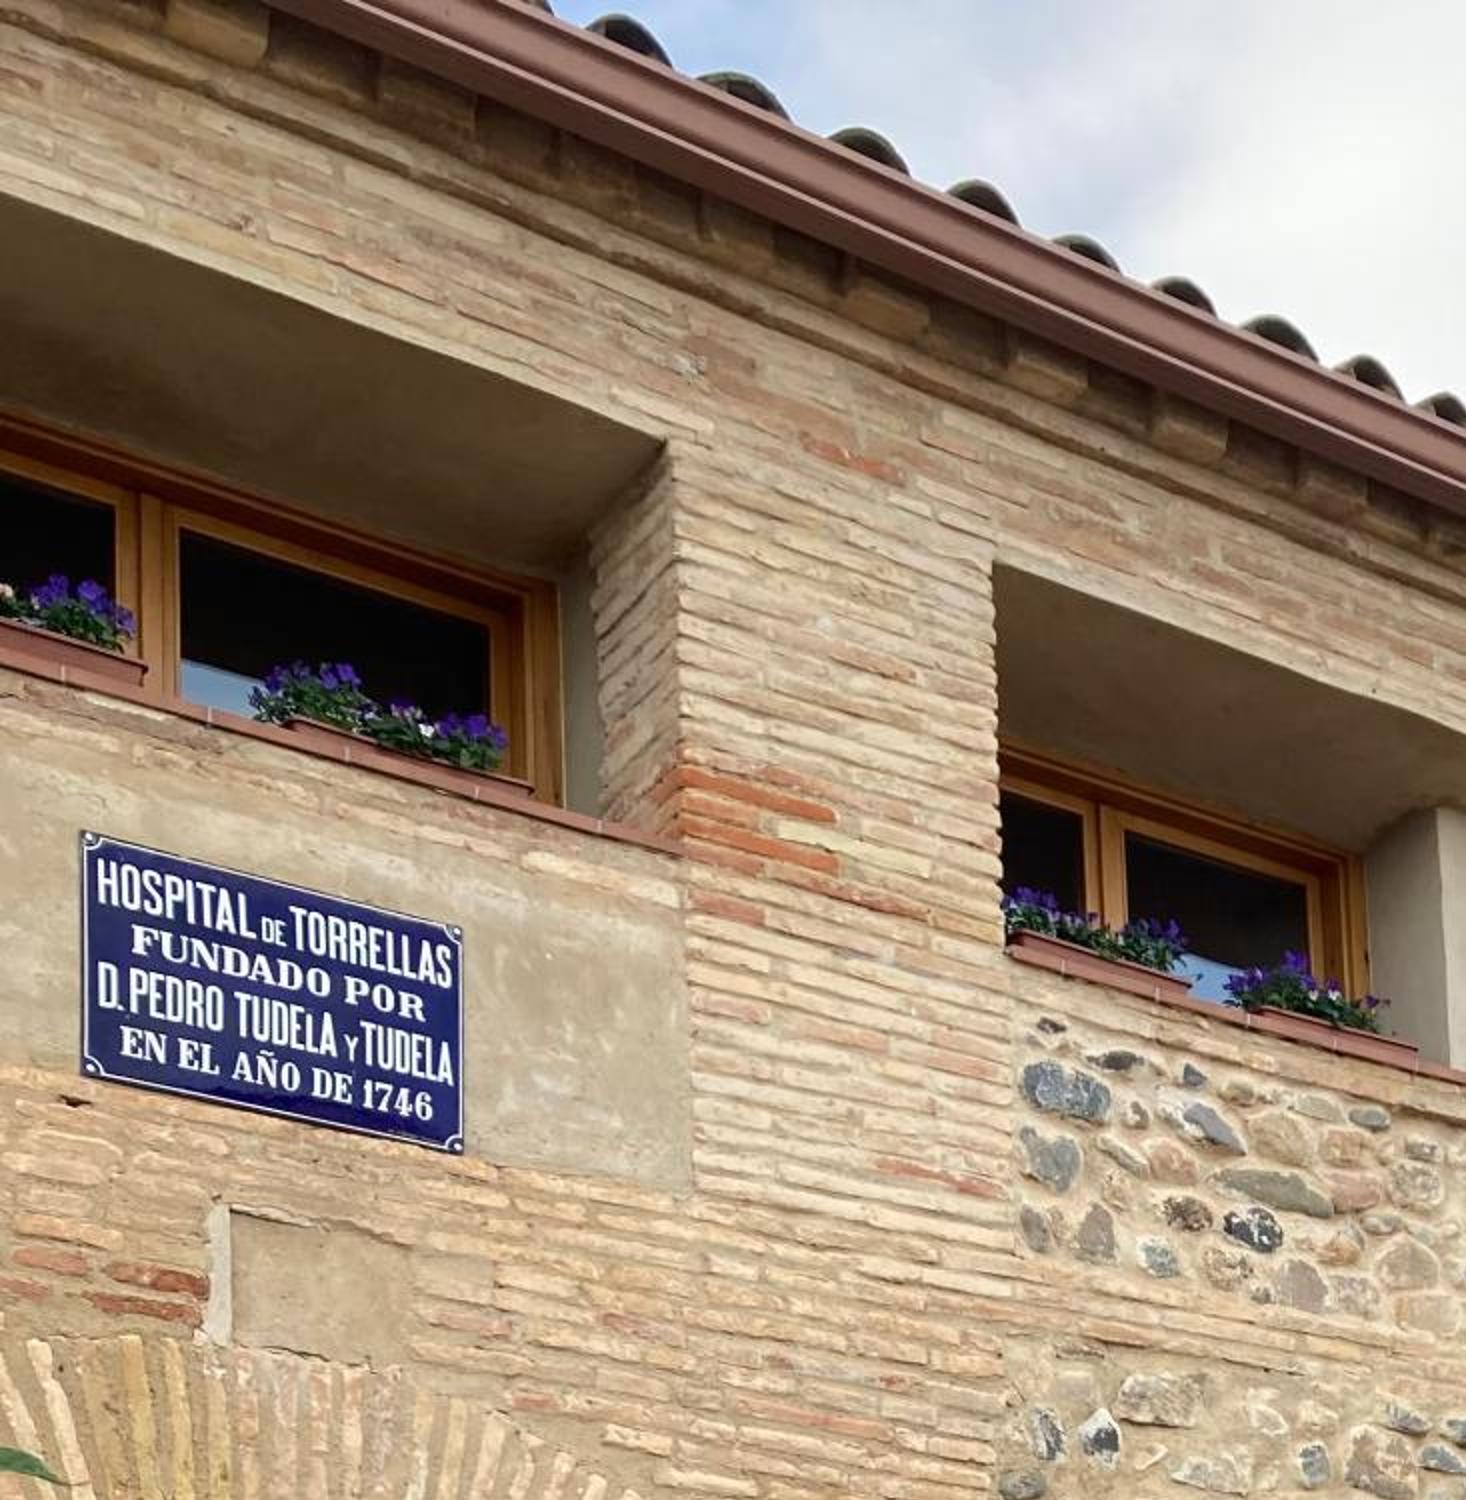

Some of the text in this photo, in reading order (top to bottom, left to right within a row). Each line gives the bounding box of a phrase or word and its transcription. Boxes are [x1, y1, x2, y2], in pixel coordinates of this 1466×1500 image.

[96, 858, 452, 988] HOSPITAL DE TORRELLAS
[131, 924, 425, 1022] FUNDADO POR
[119, 1026, 433, 1120] EN EL AÑO DE 1746
[129, 968, 224, 1031] PEDRO
[234, 992, 337, 1058] TUDELA
[344, 1035, 359, 1062] Y
[360, 1021, 453, 1085] TUDELA
